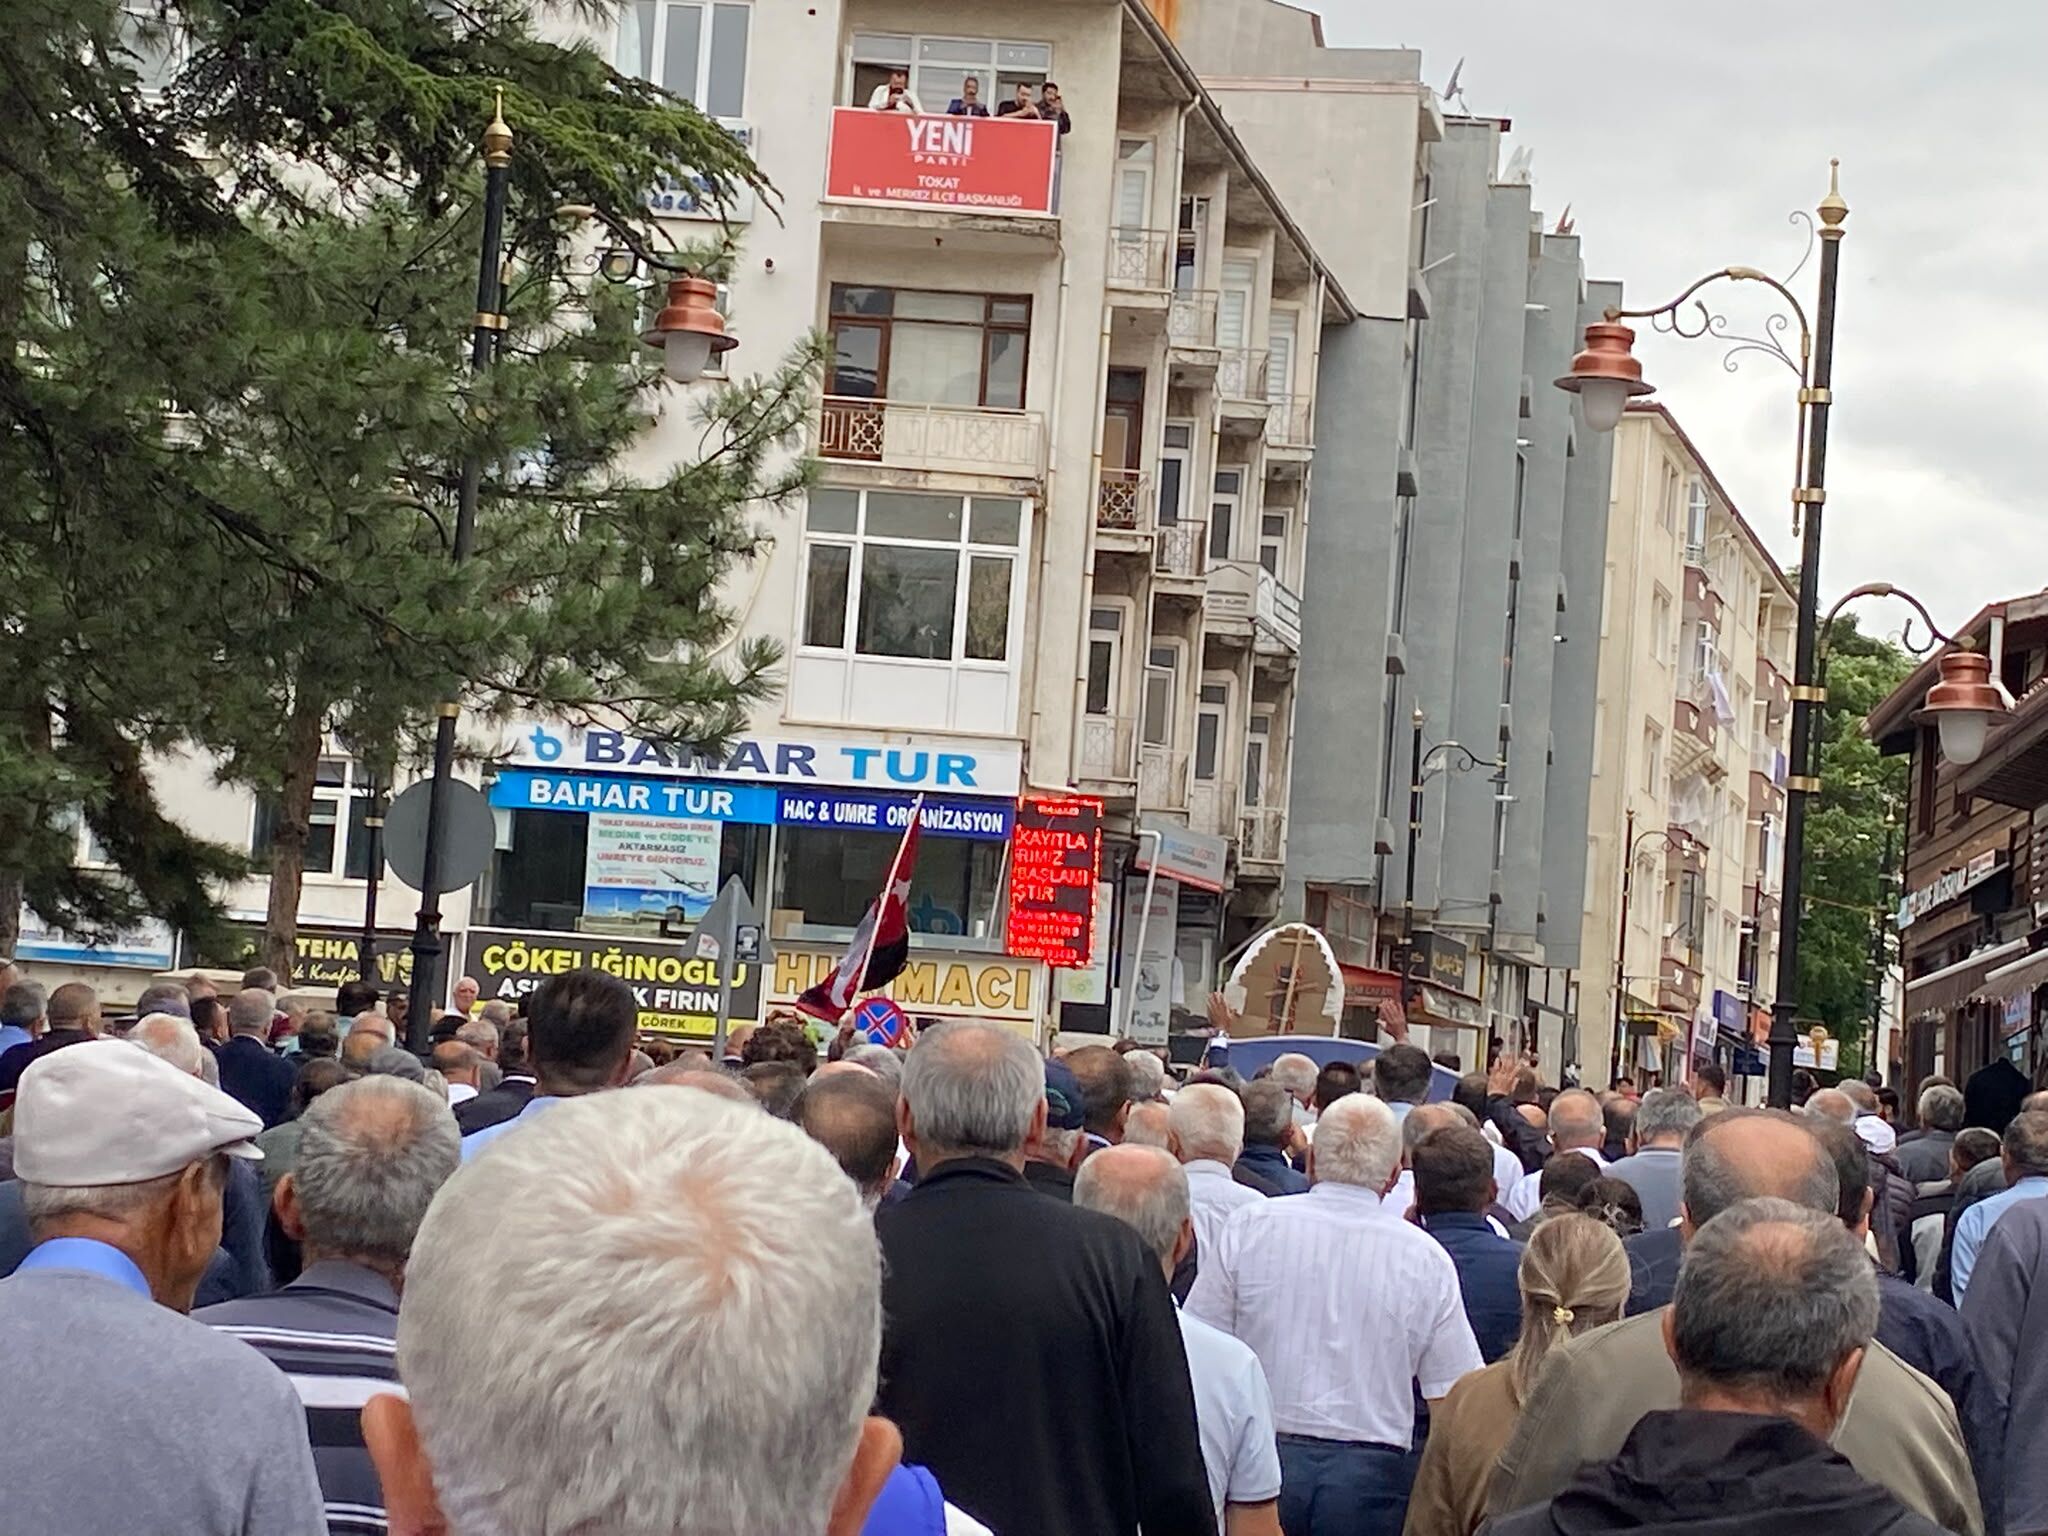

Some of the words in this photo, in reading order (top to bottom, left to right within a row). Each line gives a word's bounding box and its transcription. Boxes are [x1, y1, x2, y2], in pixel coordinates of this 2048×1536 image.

[868, 188, 881, 197] ve
[886, 187, 930, 200] MERKEZ
[918, 175, 960, 189] TOKAT
[840, 747, 978, 788] TUR
[529, 779, 651, 811] BAHAR
[663, 787, 734, 816] TUR
[783, 800, 815, 821] HAC
[818, 802, 830, 822] &
[834, 802, 877, 825] UMRE
[618, 842, 687, 854] AKTARMASIZ
[774, 952, 1031, 1010] HMACI
